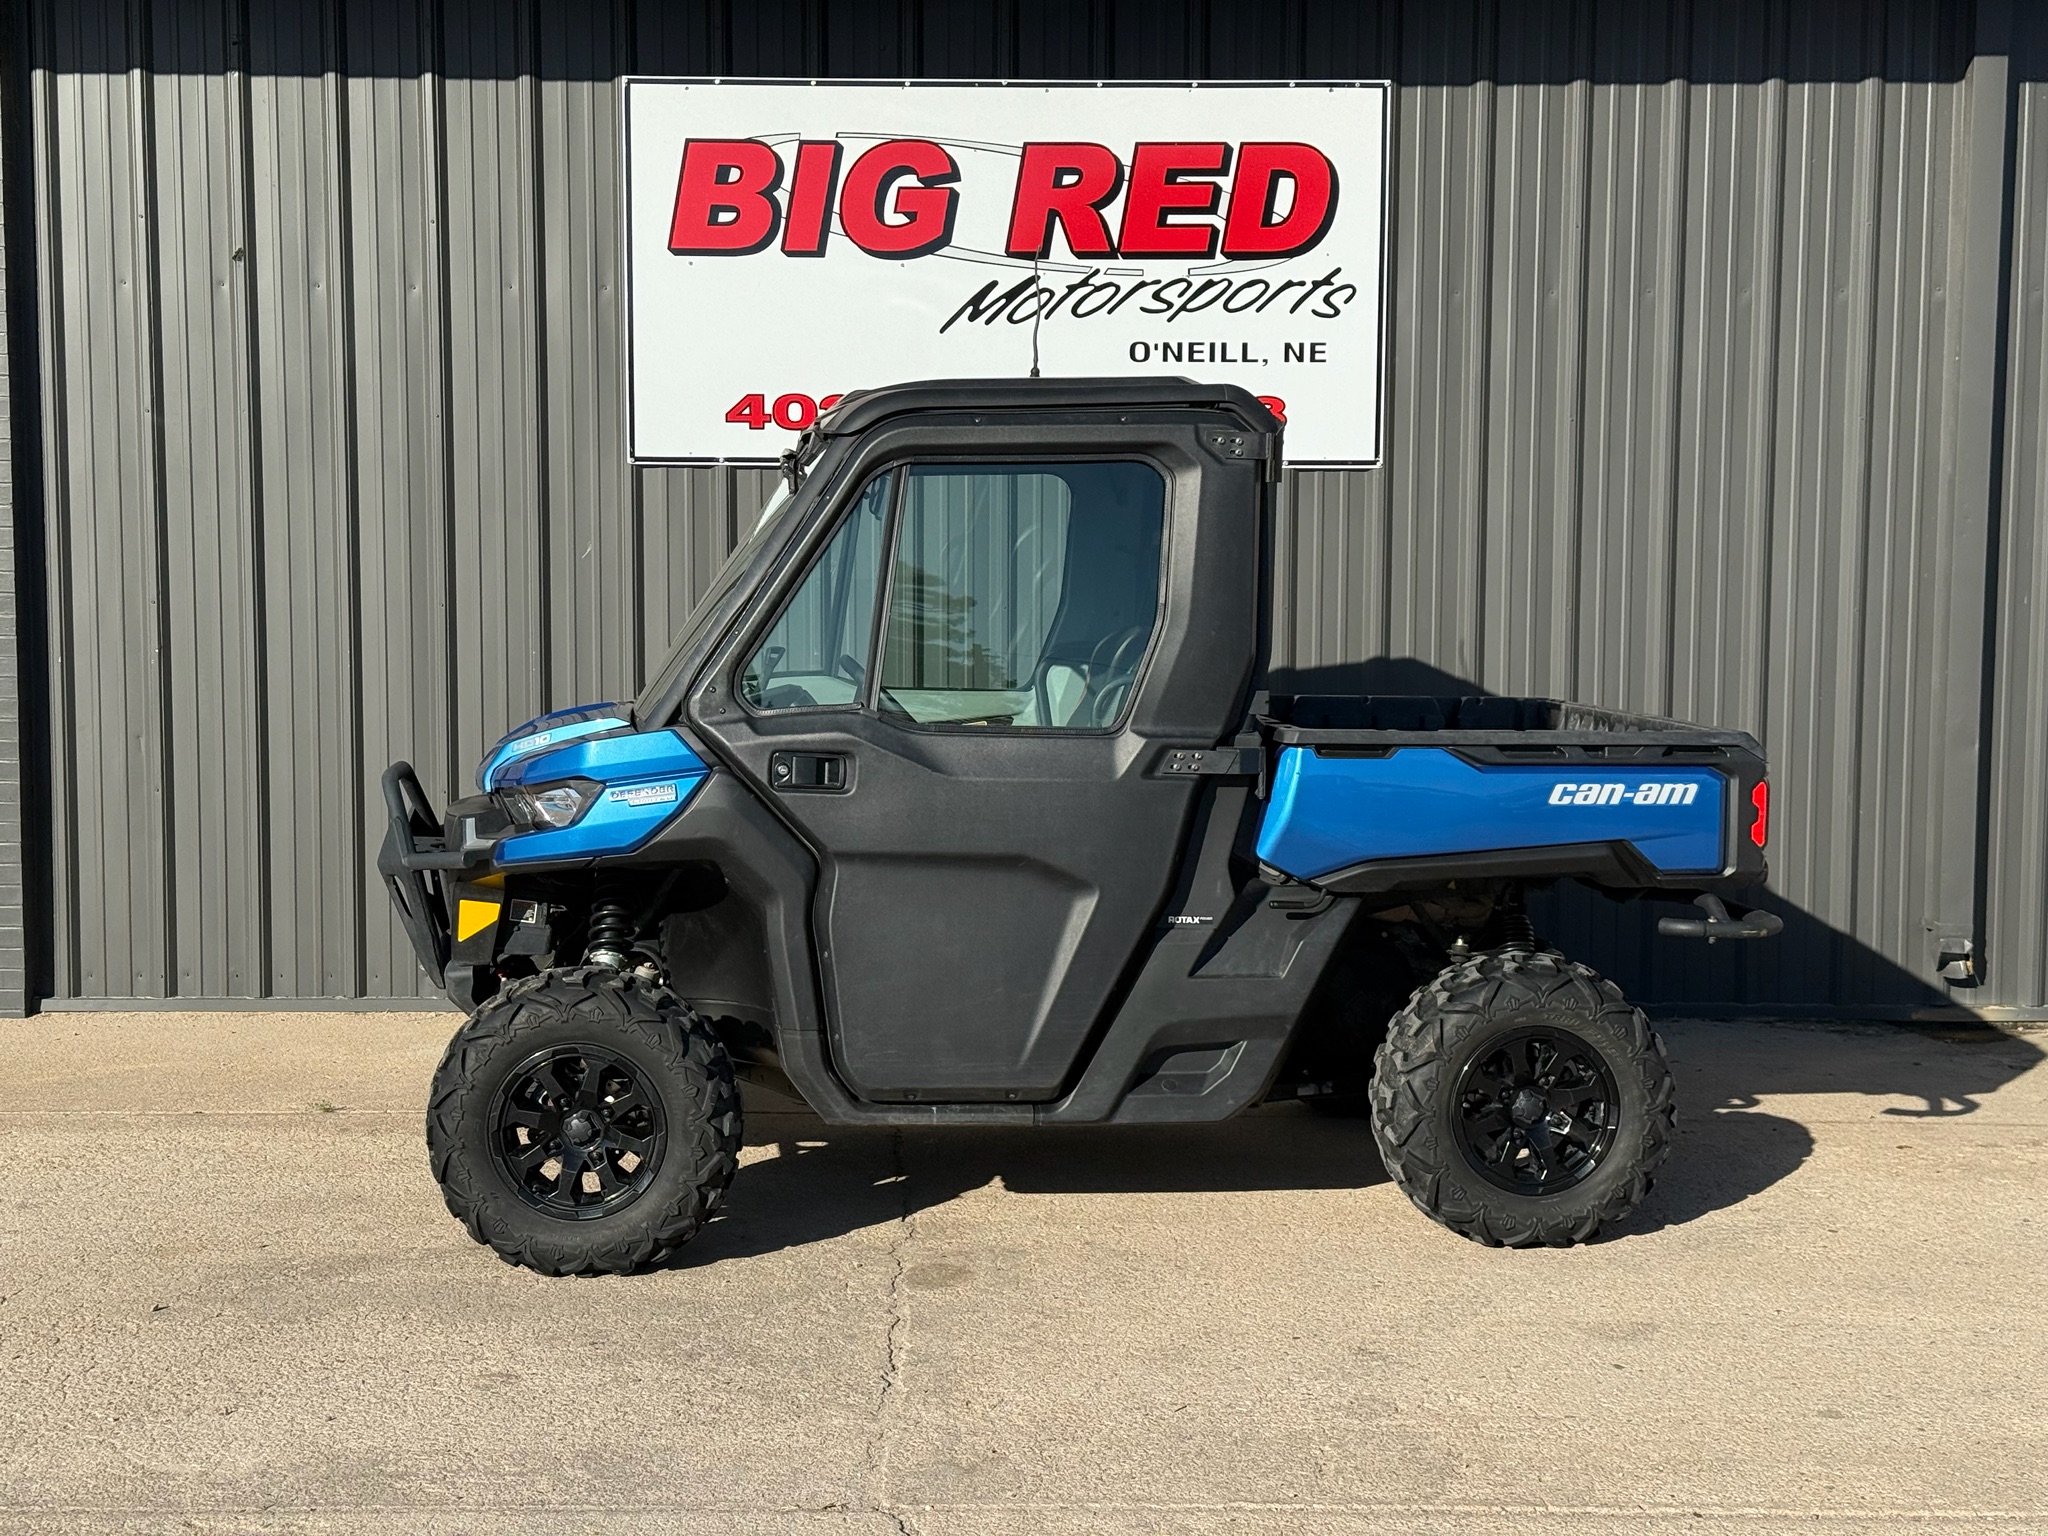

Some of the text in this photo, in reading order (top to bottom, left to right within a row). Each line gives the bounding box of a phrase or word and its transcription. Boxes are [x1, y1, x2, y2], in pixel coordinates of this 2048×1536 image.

[668, 138, 1339, 260] BIG RED
[939, 267, 1357, 334] Motorsports
[1129, 341, 1327, 366] O'NEILL, NE
[611, 784, 675, 799] DEFENDER
[1548, 783, 1698, 805] can-am
[1168, 916, 1200, 924] ROTAX
